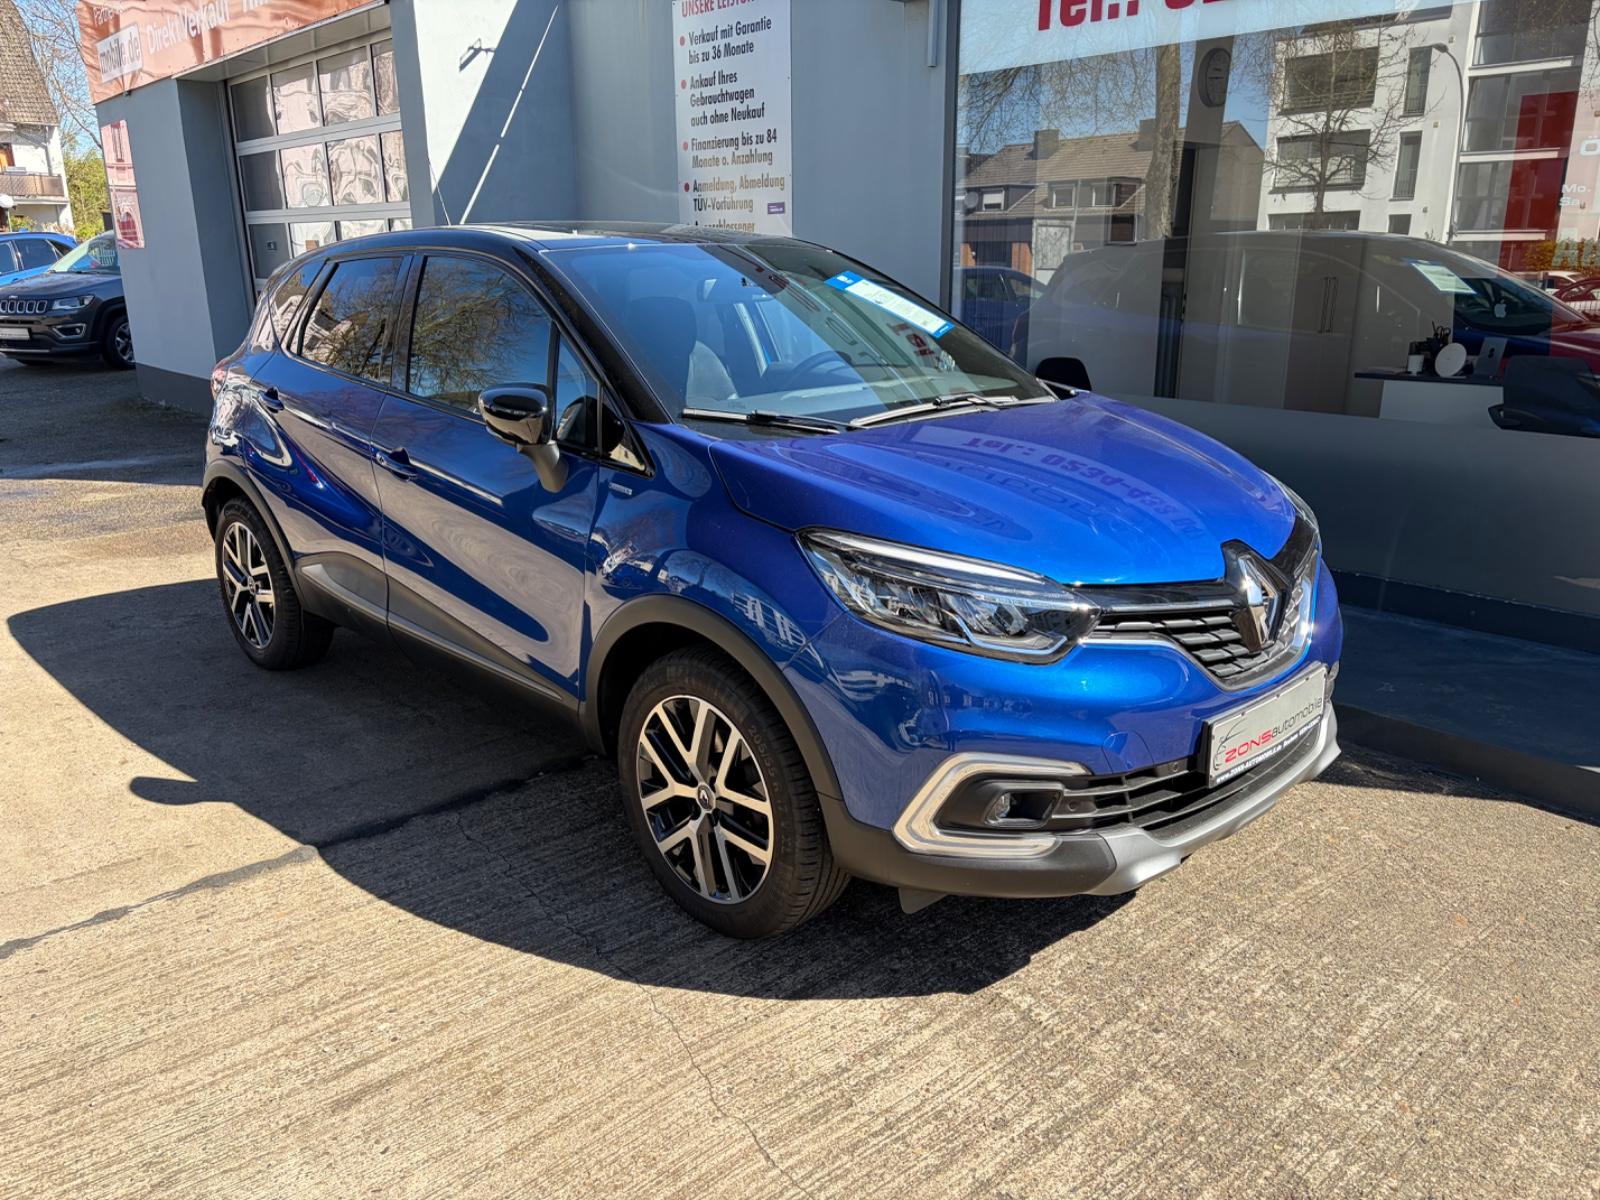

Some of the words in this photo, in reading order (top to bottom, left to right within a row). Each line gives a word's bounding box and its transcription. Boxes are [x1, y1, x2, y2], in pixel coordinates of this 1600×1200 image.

[682, 0, 715, 17] UNSERE
[689, 25, 718, 46] Verkauf
[720, 24, 733, 40] mit
[735, 16, 772, 36] Garantie
[100, 32, 141, 75] mobile.de
[689, 50, 699, 64] bis
[701, 49, 710, 62] zu
[712, 45, 722, 60] 36
[724, 40, 754, 58] Monate
[690, 70, 716, 90] Ankauf
[718, 69, 738, 85] Ihres
[690, 87, 755, 108] Gebrauchtwagen
[690, 110, 708, 127] auch
[710, 109, 729, 124] ohne
[731, 102, 765, 121] Neukauf
[691, 136, 739, 151] Finanzierung
[741, 131, 753, 146] bis
[755, 133, 764, 144] zu
[766, 128, 777, 143] 84
[692, 154, 720, 169] Monate
[722, 157, 729, 165] o.
[731, 148, 773, 166] Anzahlung
[693, 176, 737, 194] Anmeldung,
[739, 173, 785, 191] Abmeldung
[693, 194, 753, 213] TÜV-Vorführung
